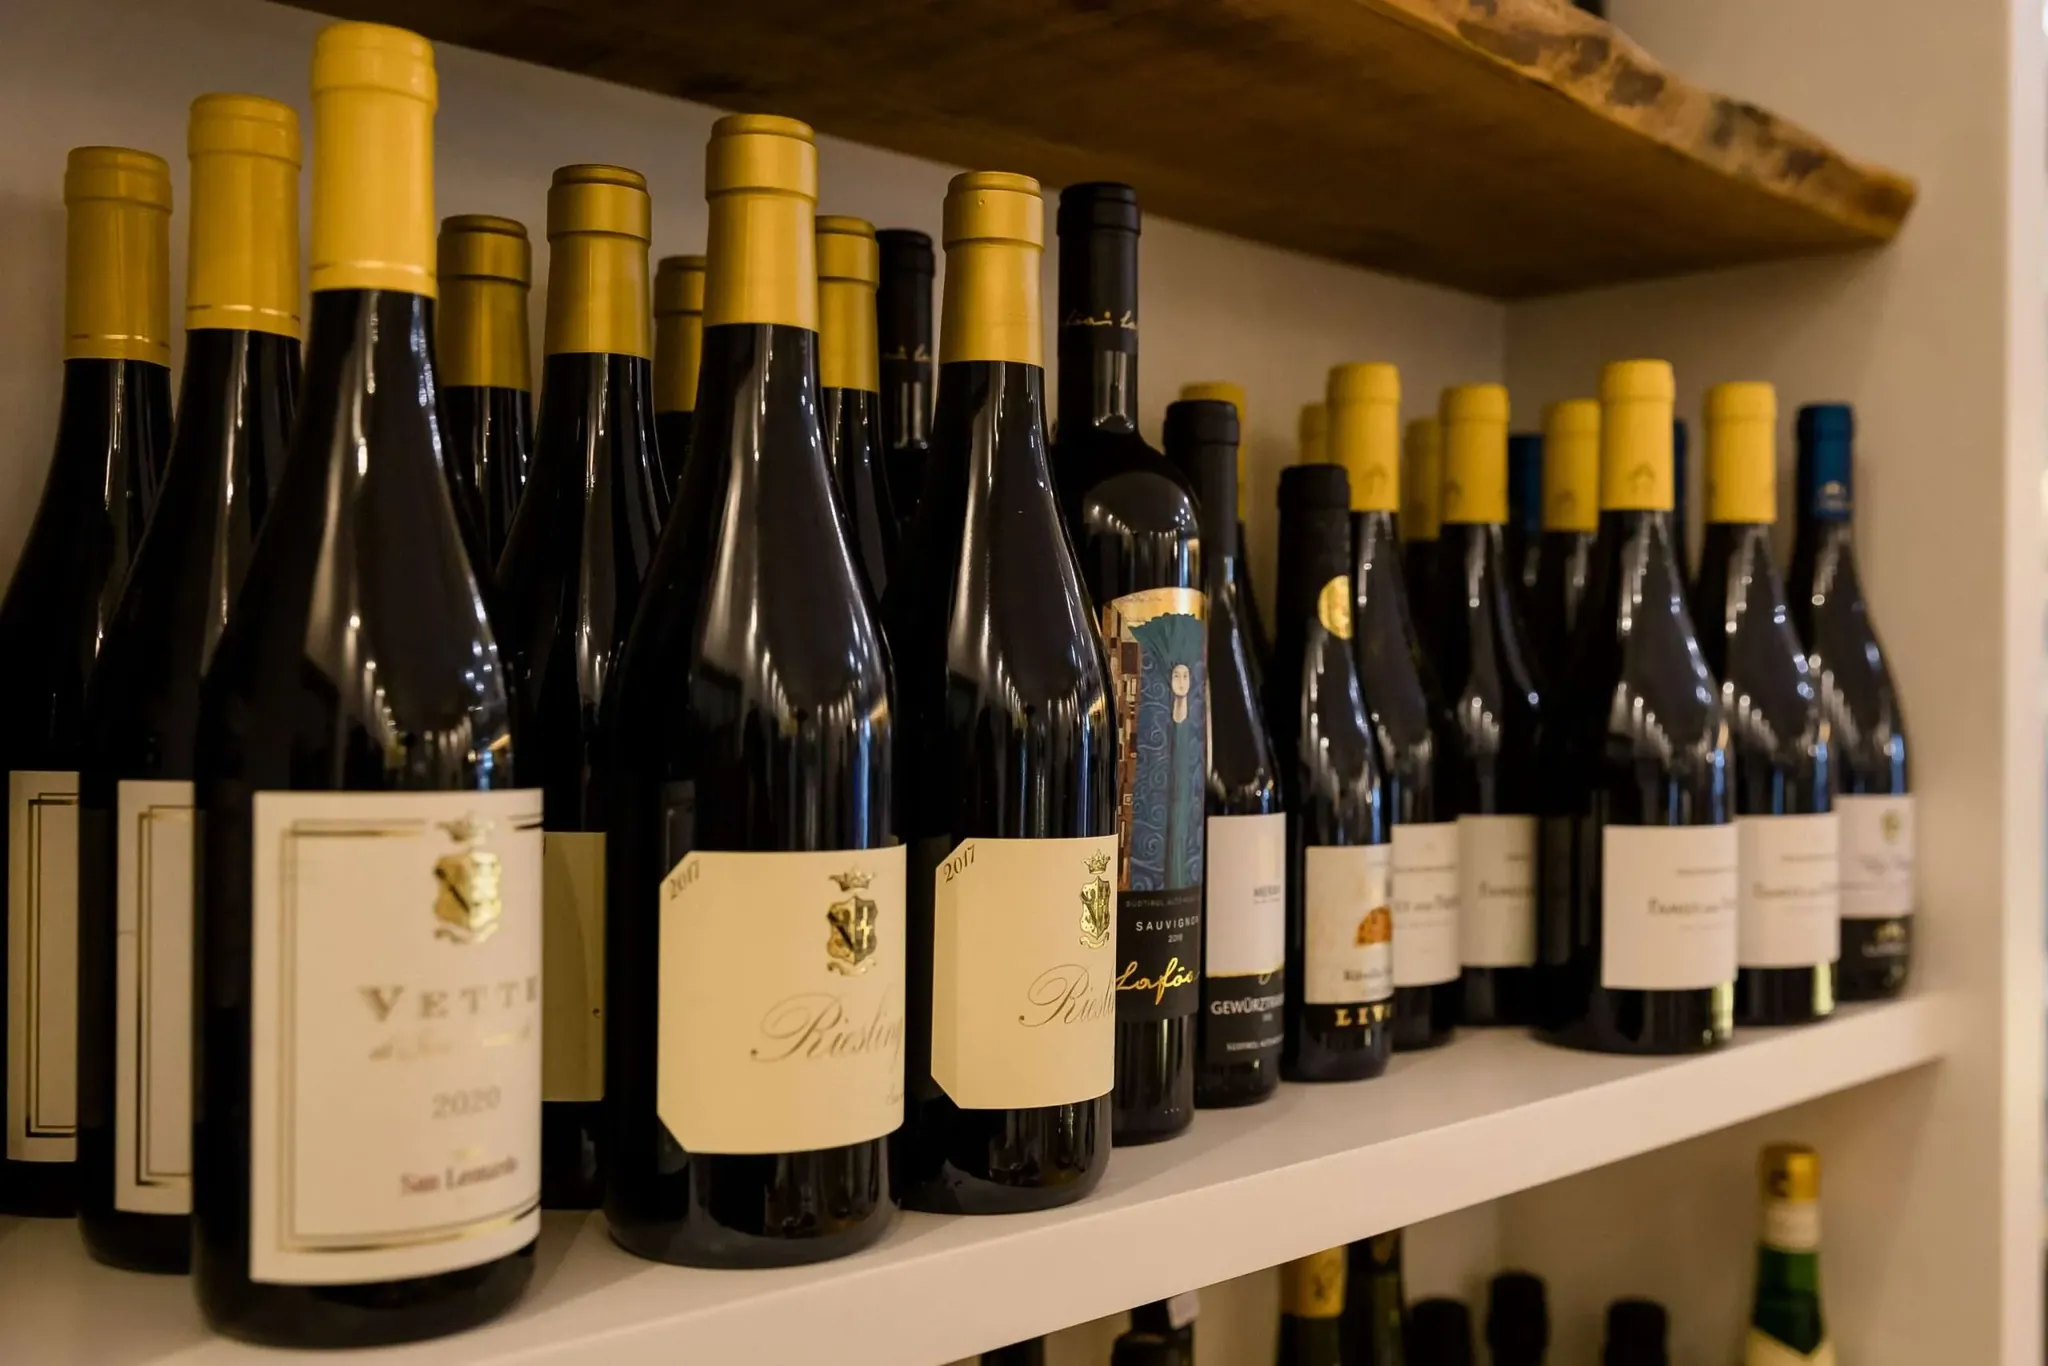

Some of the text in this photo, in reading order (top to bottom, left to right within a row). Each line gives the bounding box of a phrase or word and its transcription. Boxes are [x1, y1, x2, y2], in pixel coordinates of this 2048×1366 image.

[669, 859, 700, 902] 2017
[943, 843, 976, 884] 2017
[430, 1084, 502, 1120] 2020
